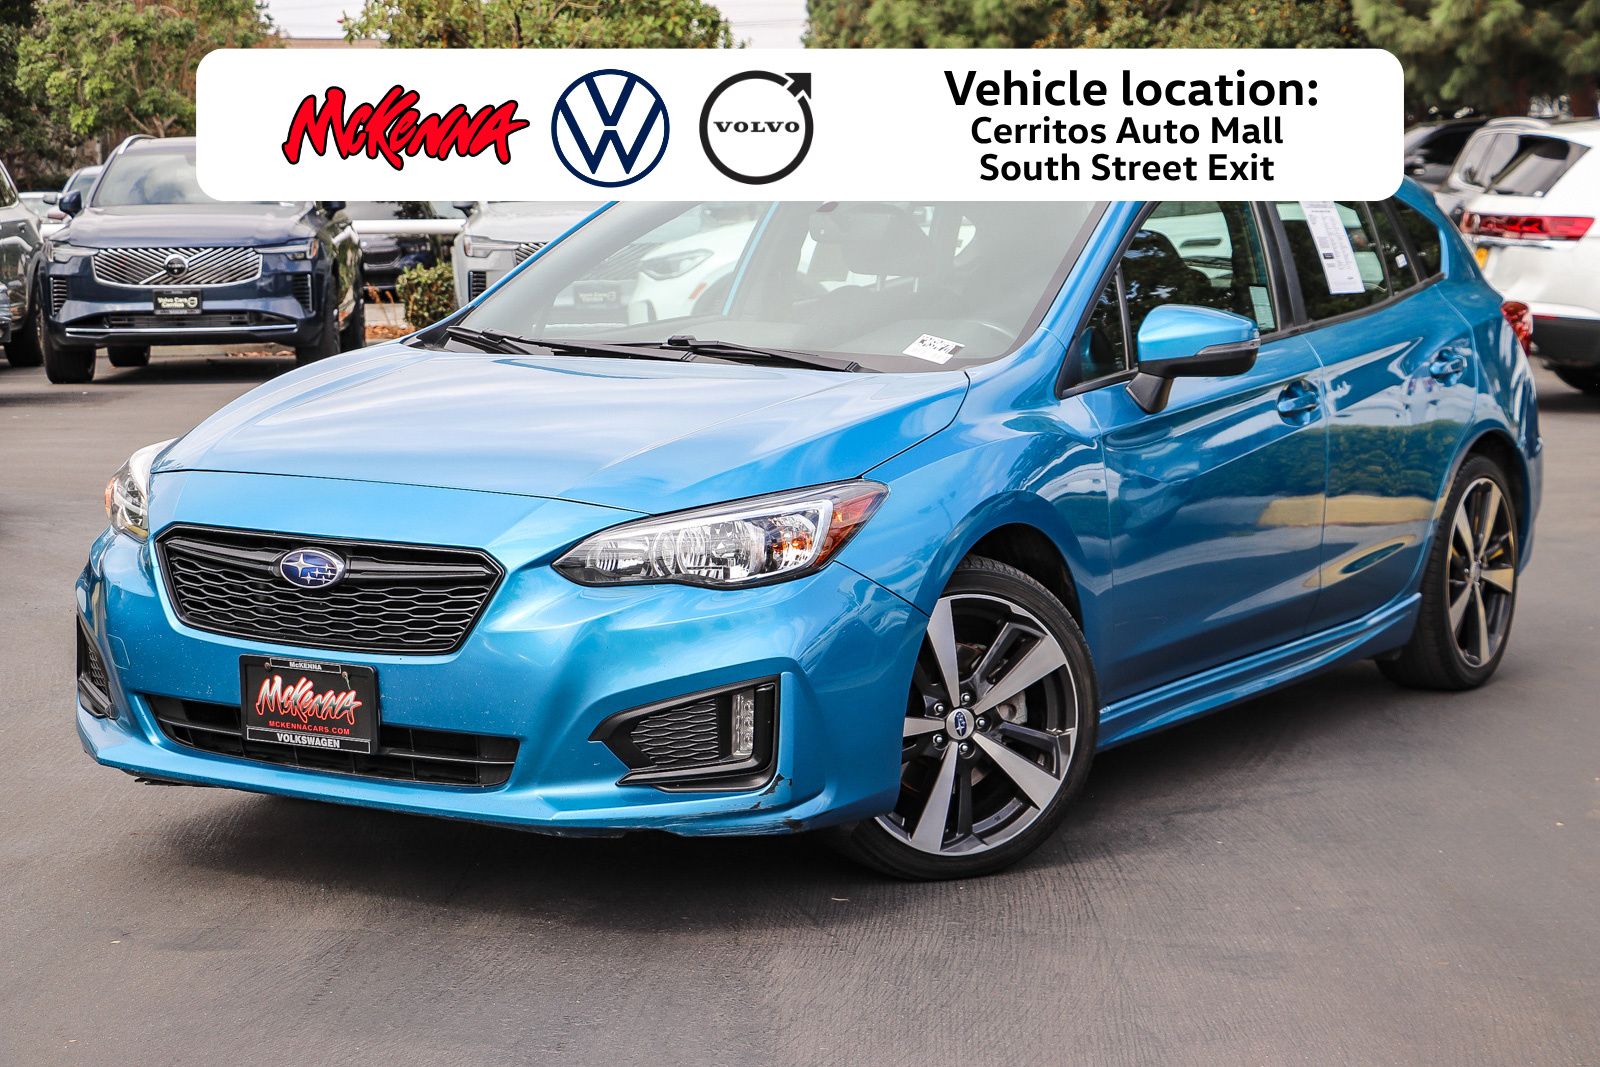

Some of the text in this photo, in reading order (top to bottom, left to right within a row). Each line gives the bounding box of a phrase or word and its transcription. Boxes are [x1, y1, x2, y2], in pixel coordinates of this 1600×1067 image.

[289, 661, 322, 671] McKENNA
[269, 720, 350, 735] MCKENNACARS.COM
[276, 732, 340, 748] VOLKSWAGEN
